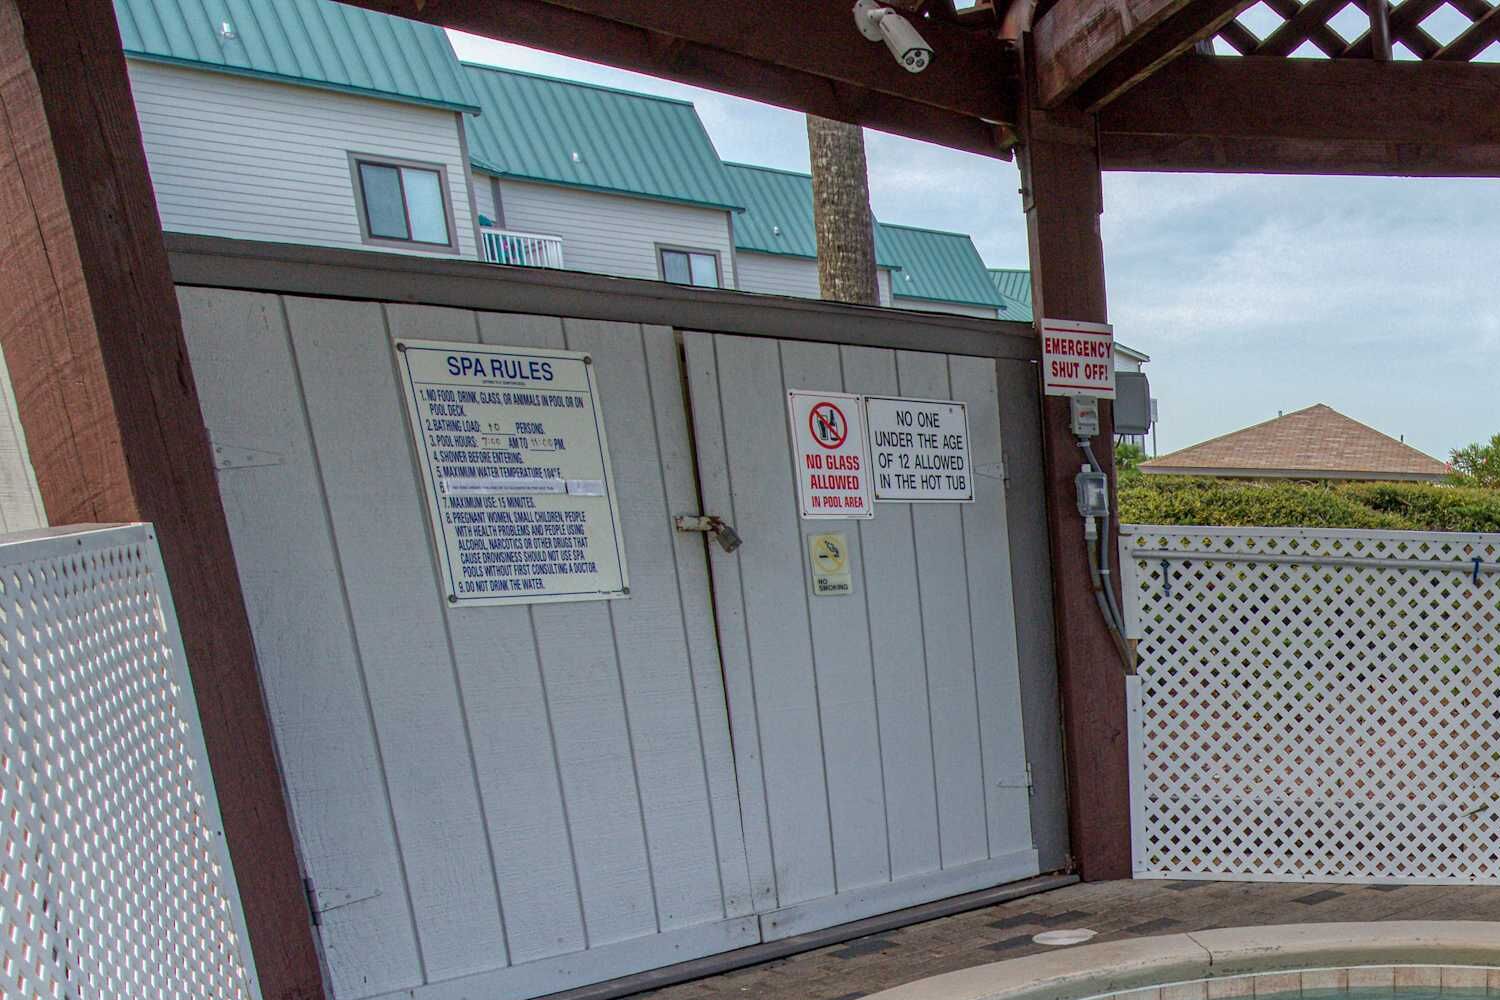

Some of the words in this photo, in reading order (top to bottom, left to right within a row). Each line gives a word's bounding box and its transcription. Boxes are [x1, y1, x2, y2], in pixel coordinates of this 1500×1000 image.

[1045, 338, 1112, 360] EMERGENCY
[448, 356, 486, 376] SPA
[491, 359, 554, 381] RULES
[1052, 361, 1080, 378] SHUT
[1085, 363, 1108, 380] OFF!
[426, 390, 436, 401] NO
[503, 393, 512, 405] OR
[513, 393, 540, 406] ANIMALS
[541, 395, 549, 406] IN
[549, 396, 565, 407] POOL
[566, 396, 574, 407] OR
[575, 397, 584, 408] ON
[430, 403, 447, 415] POOL
[433, 420, 462, 432] BATHING
[896, 410, 912, 427] NO
[918, 412, 940, 428] ONE
[436, 435, 454, 447] POOL
[454, 435, 479, 447] HOURS:
[509, 437, 519, 449] AM
[520, 437, 528, 449] TO
[875, 431, 913, 448] UNDER
[917, 434, 938, 448] THE
[943, 435, 963, 450] AGE
[440, 451, 468, 462] SHOWER
[468, 451, 492, 463] BEFORE
[806, 454, 822, 469] NO
[826, 455, 860, 470] GLASS
[879, 453, 893, 468] OF
[899, 454, 909, 469] 12
[915, 455, 964, 470] ALLOWED
[443, 466, 476, 478] MAXIMUM
[476, 466, 499, 478] WATER
[500, 467, 543, 479] TEMPERATURE
[810, 474, 859, 490] ALLOWED
[880, 474, 890, 488] IN
[895, 474, 917, 489] THE
[921, 475, 942, 490] HOT
[946, 475, 966, 490] TUB
[450, 497, 482, 508] MAXIMUM
[498, 497, 506, 508] 15
[812, 496, 820, 507] IN
[824, 496, 842, 507] POOL
[845, 497, 863, 508] AREA
[453, 512, 484, 523] PREGNANT
[514, 512, 534, 523] SMALL
[565, 511, 586, 522] PEOPLE
[455, 525, 472, 536] WITH
[473, 525, 497, 536] HEALTH
[498, 525, 530, 536] PROBLEMS
[532, 525, 543, 536] AND
[544, 524, 566, 535] PEOPLE
[567, 524, 584, 535] USING
[489, 538, 523, 549] NARCOTICS
[524, 538, 532, 549] OR
[533, 537, 554, 548] OTHER
[554, 537, 572, 548] DRUGS
[573, 537, 588, 547] THAT
[461, 552, 481, 564] CAUSE
[482, 552, 522, 563] DROWSINESS
[524, 550, 546, 562] SHOULD
[548, 550, 559, 561] NOT
[560, 550, 572, 560] USE
[573, 550, 585, 560] SPA
[463, 566, 483, 577] POOLS
[485, 565, 512, 576] WITHOUT
[514, 564, 530, 575] FIRST
[532, 563, 568, 575] CONSULTING
[569, 563, 573, 573] A
[465, 581, 474, 592] DO
[476, 581, 488, 592] NOT
[490, 580, 508, 592] DRINK
[510, 580, 520, 590] THE
